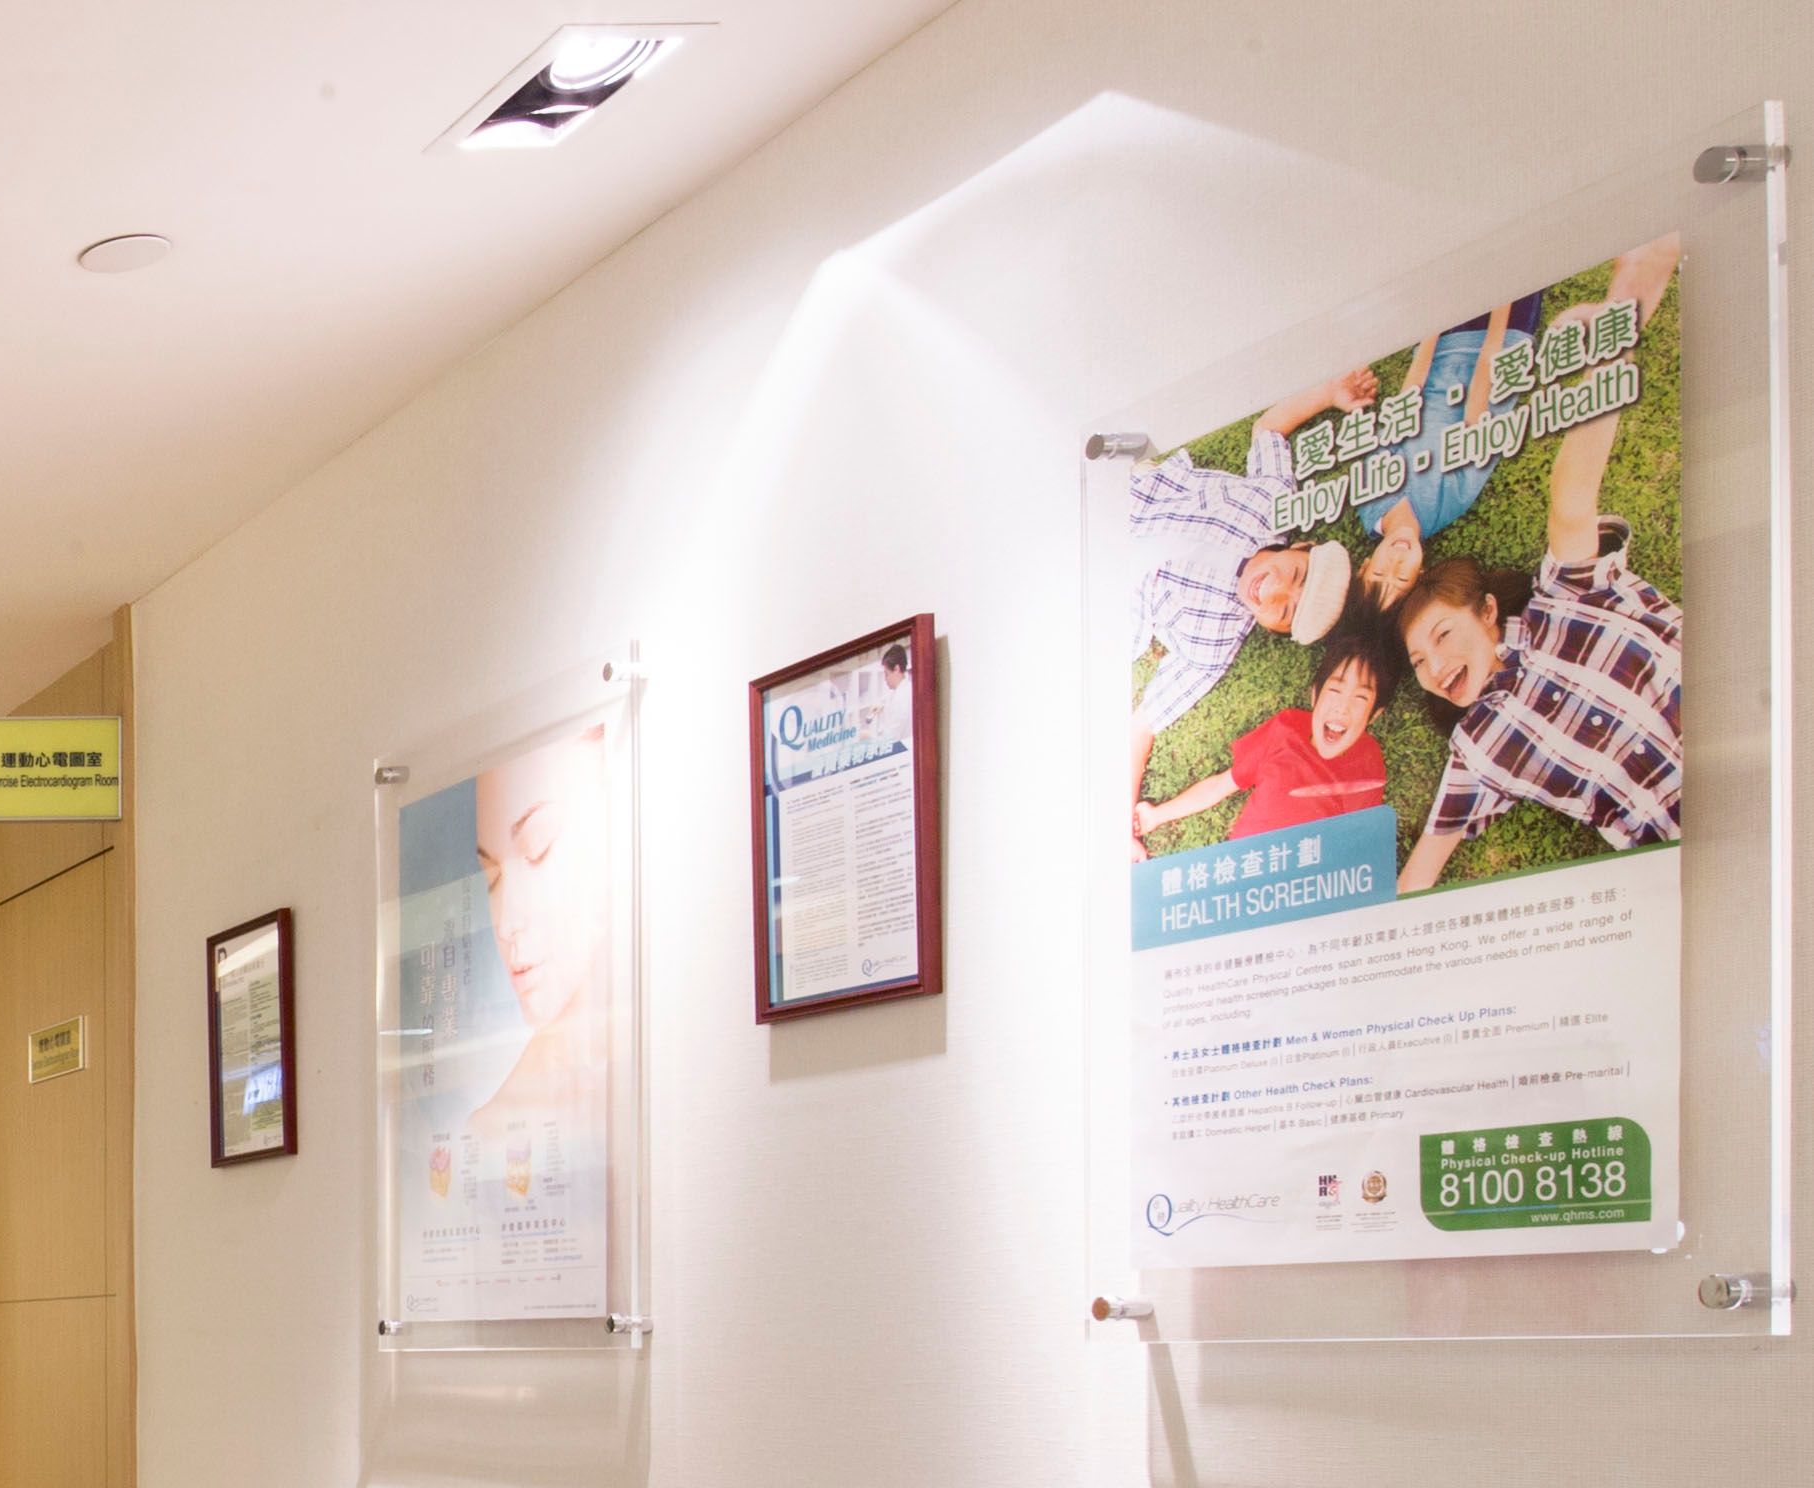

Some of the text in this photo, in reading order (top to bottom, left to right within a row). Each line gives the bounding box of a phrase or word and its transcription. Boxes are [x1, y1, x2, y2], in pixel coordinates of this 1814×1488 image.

[1298, 303, 1636, 474] 愛生活 愛健康
[1274, 367, 1636, 531] Enjoy Life Enjoy Health
[808, 726, 857, 752] Medicine
[1, 752, 103, 768] 運動心電圖室
[20, 774, 92, 790] Electrocardiogram
[94, 773, 119, 786] Room
[1161, 835, 1322, 897] 體格檢查計劃
[1161, 864, 1373, 932] HEALTH SCREENING
[1252, 968, 1291, 984] Physical
[1295, 961, 1334, 976] Centres
[1338, 957, 1363, 971] span
[1367, 951, 1402, 965] across
[1407, 945, 1435, 958] Hong
[1478, 934, 1495, 945] We
[1501, 928, 1527, 942] offer
[1532, 928, 1540, 936] a
[1546, 920, 1573, 934] wide
[1579, 914, 1614, 928] range
[1620, 908, 1633, 922] of
[1163, 930, 1633, 1016] professional health screening packages to accommodate the various needs of men and women
[1286, 1034, 1308, 1045] Men
[1311, 1032, 1319, 1042] &
[1322, 1027, 1363, 1040] Women
[1366, 1019, 1414, 1035] Physical
[1417, 1013, 1454, 1028] Check
[1459, 1011, 1475, 1023] Up
[1479, 1005, 1517, 1019] Plans:
[1505, 1021, 1549, 1034] Premium
[1585, 1013, 1609, 1025] Elite
[1234, 1088, 1262, 1101] Other
[1266, 1084, 1299, 1097] Health
[1302, 1079, 1335, 1092] Check
[1339, 1075, 1374, 1088] Plans:
[1405, 1083, 1474, 1099] Cardiovascular
[1477, 1078, 1509, 1090] Health
[1565, 1065, 1624, 1081] Pre-marital
[1205, 1126, 1242, 1137] Domestic
[1370, 1109, 1405, 1120] Primary
[1440, 1145, 1624, 1171] Physical Check-up Hotline
[1439, 1160, 1627, 1208] 8100 8138
[1207, 1193, 1282, 1211] HealthCare
[1530, 1207, 1626, 1224] www.qhms.com
